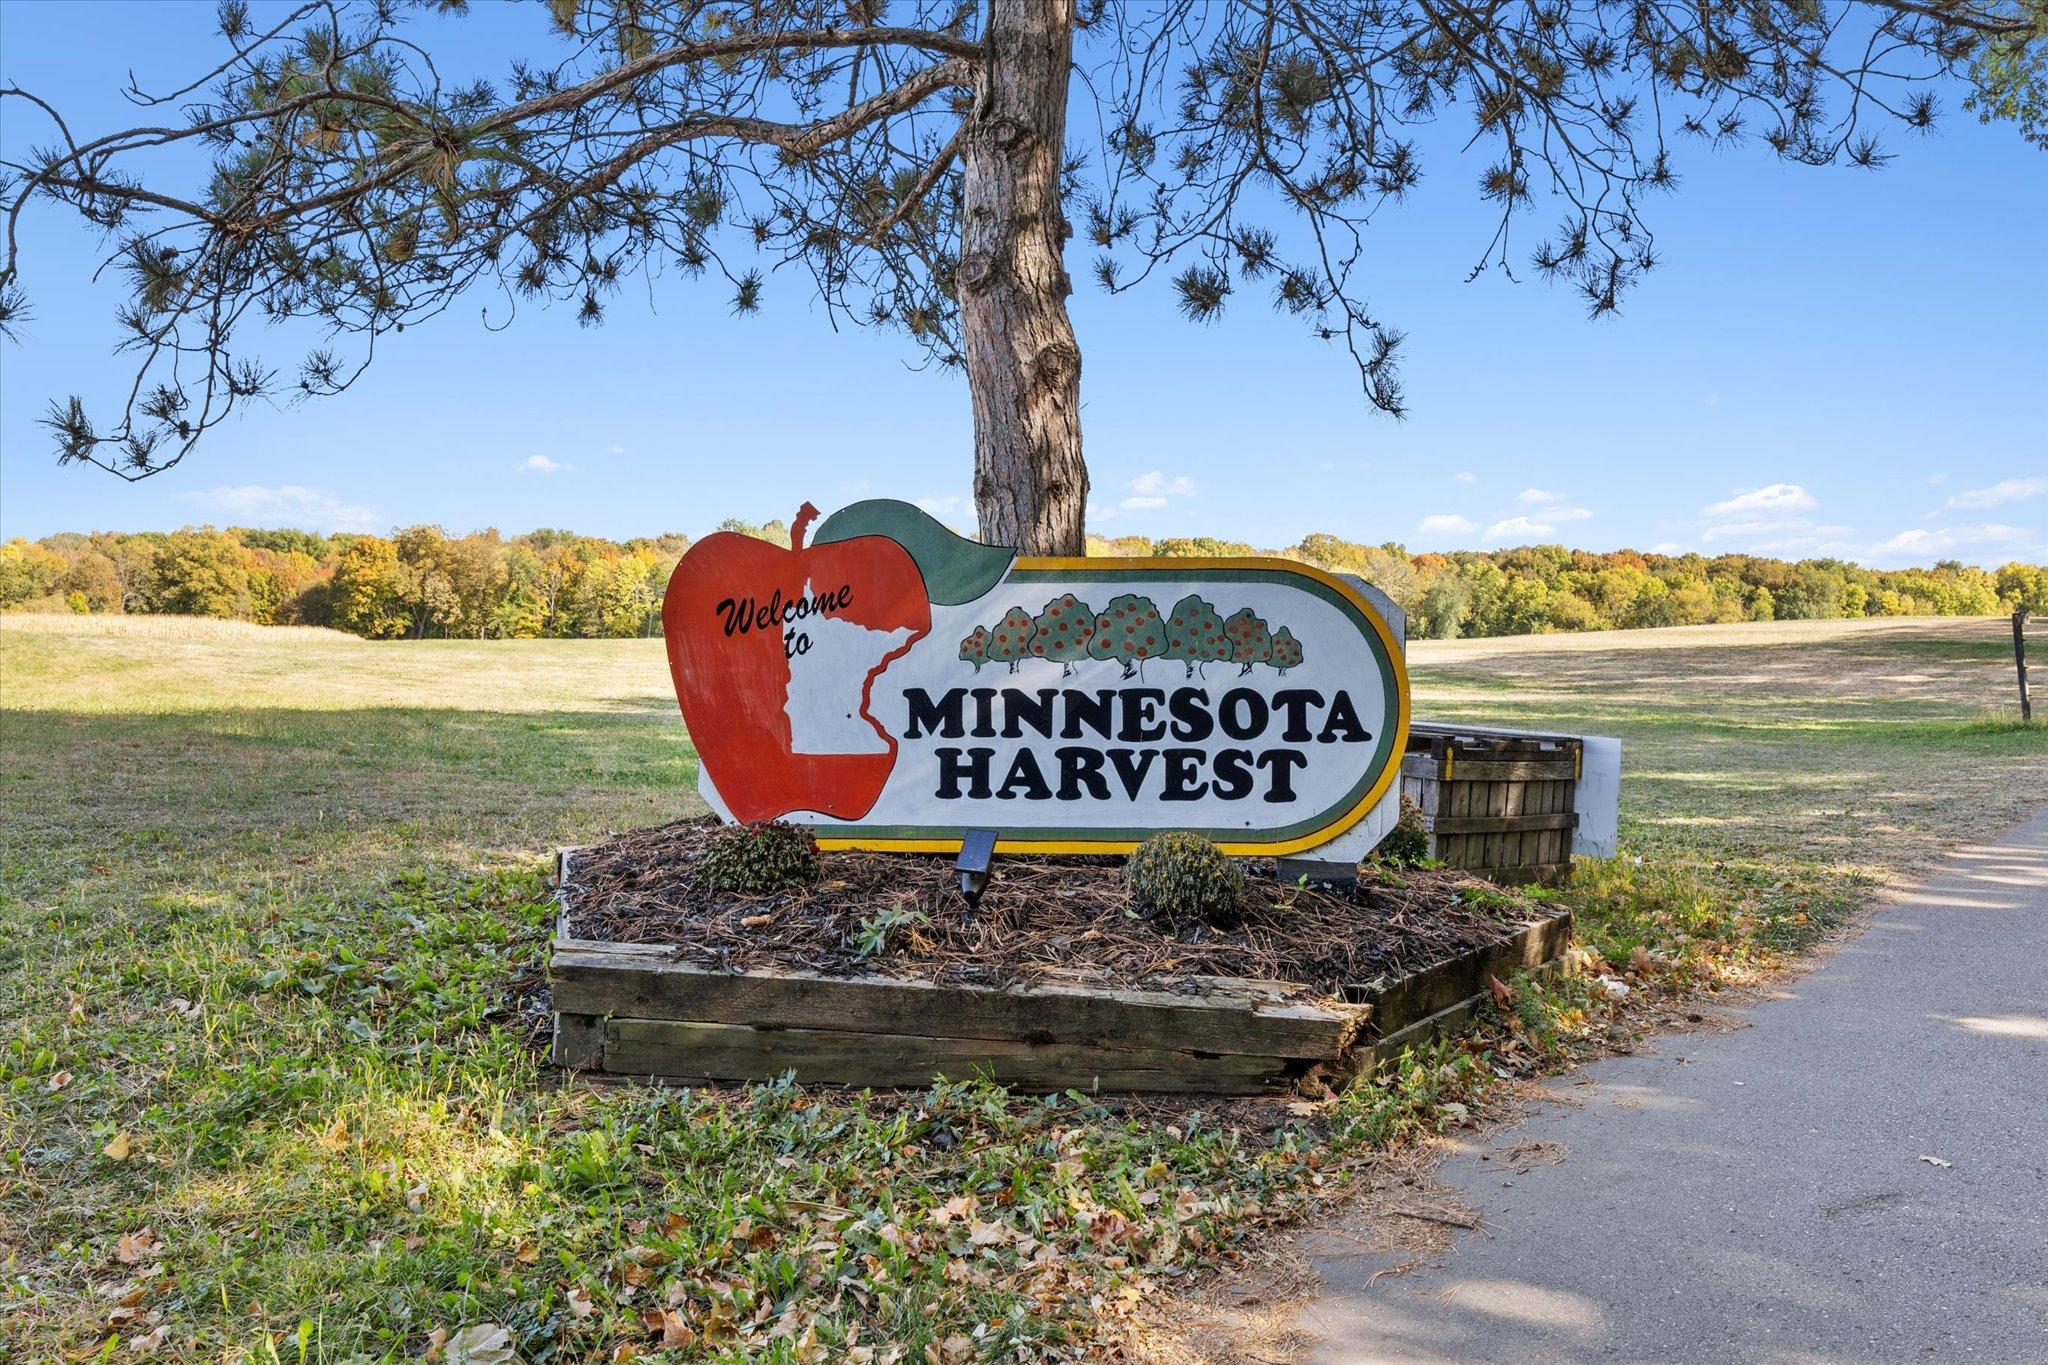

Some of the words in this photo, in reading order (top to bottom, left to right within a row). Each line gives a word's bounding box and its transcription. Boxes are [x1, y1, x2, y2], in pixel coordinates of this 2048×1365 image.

[716, 584, 854, 637] Welcome
[783, 627, 814, 660] to
[902, 687, 1373, 743] MINNESOTA
[935, 747, 1308, 803] HARVEST
